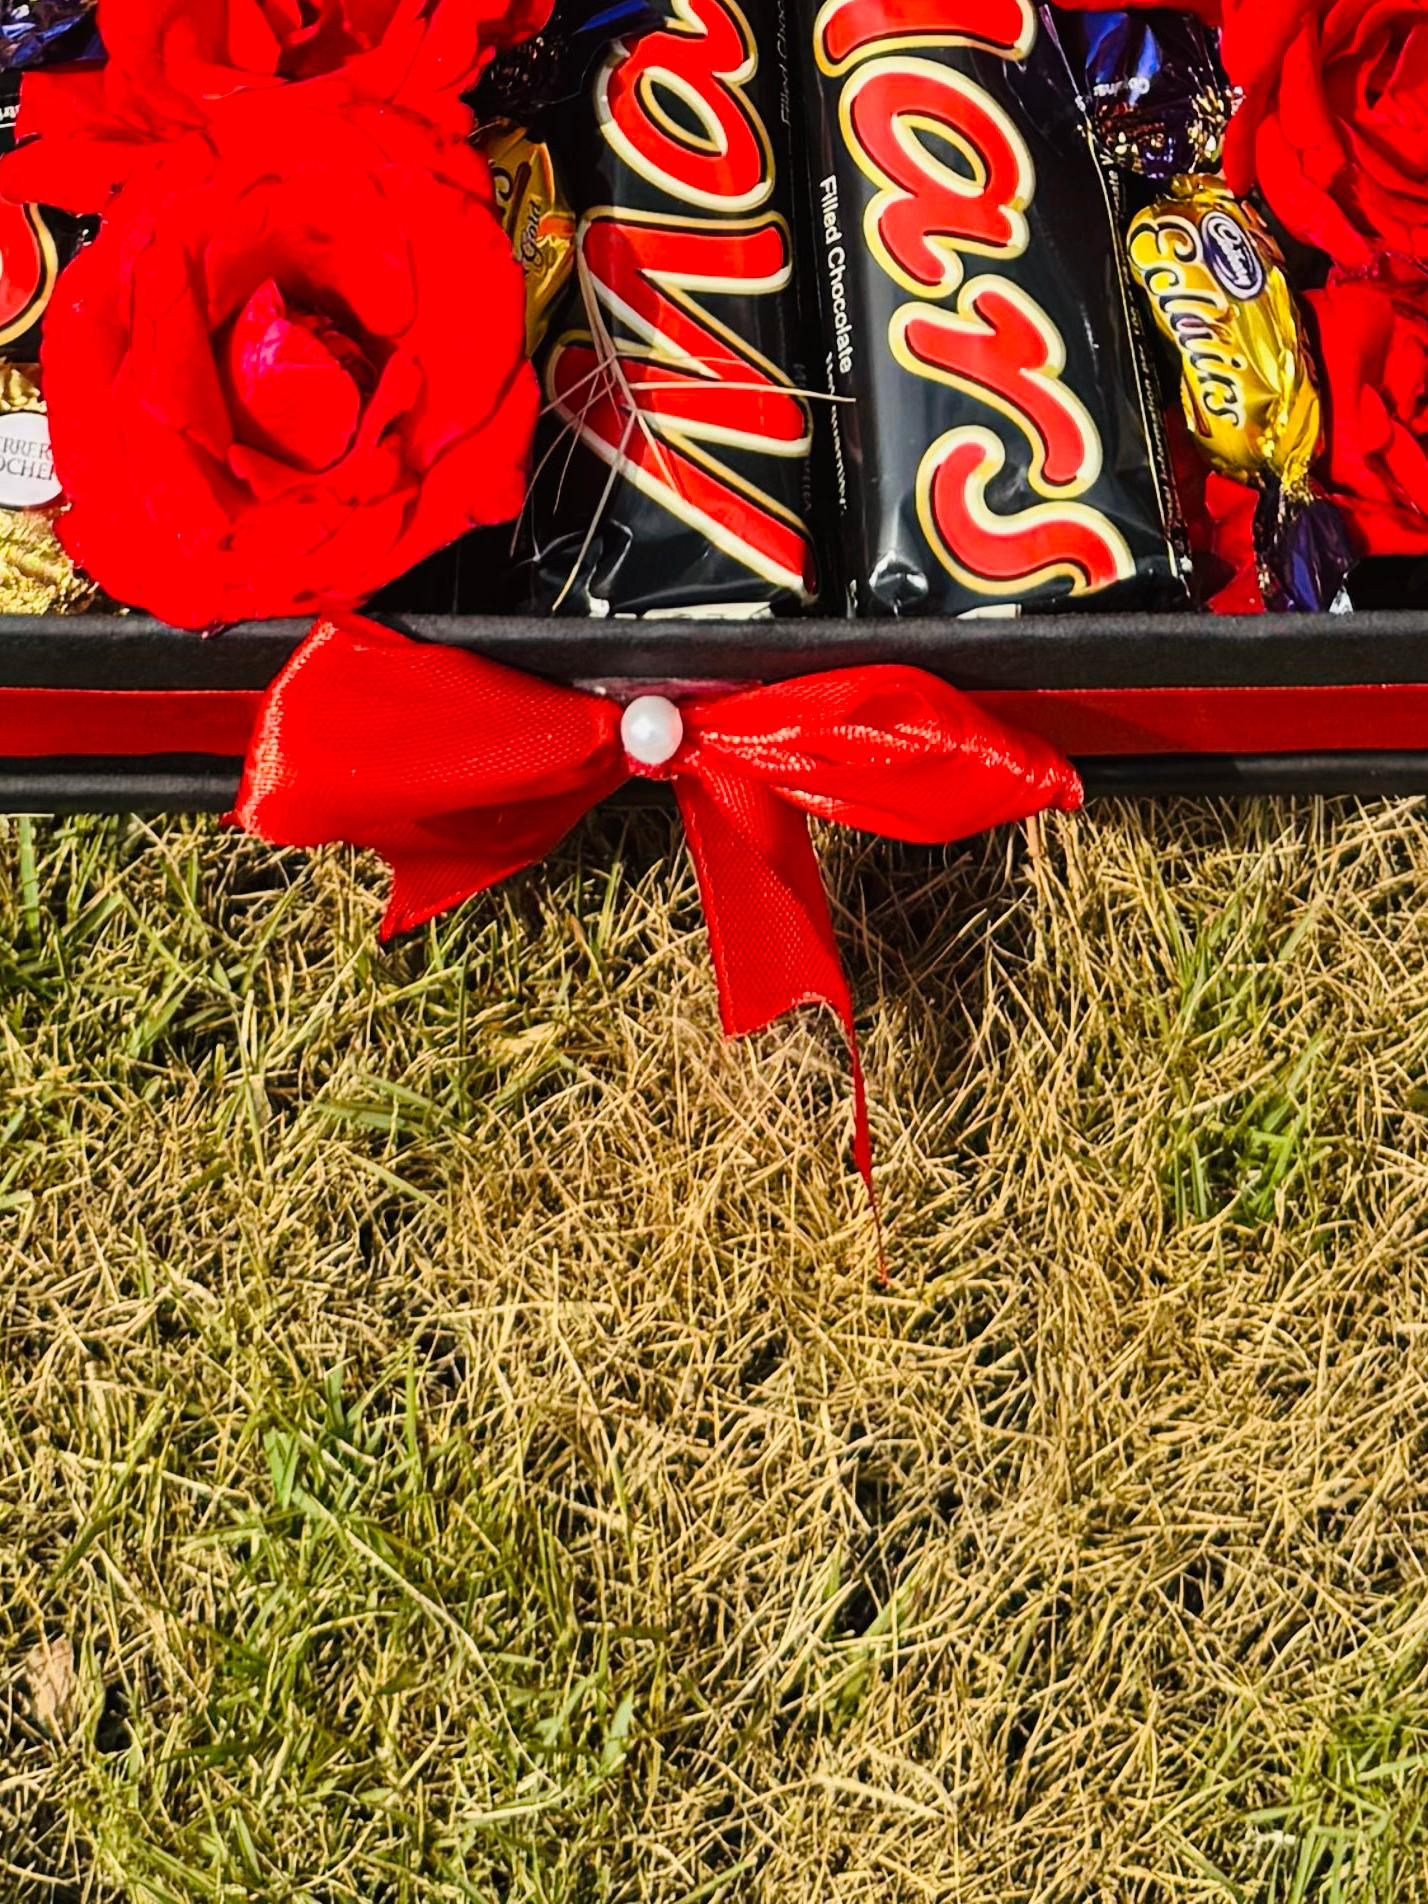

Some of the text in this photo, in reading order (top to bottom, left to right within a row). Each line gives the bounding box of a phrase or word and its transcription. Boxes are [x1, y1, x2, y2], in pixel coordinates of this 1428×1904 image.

[817, 175, 859, 373] Filled Chocolate
[1127, 214, 1247, 431] Eclairs
